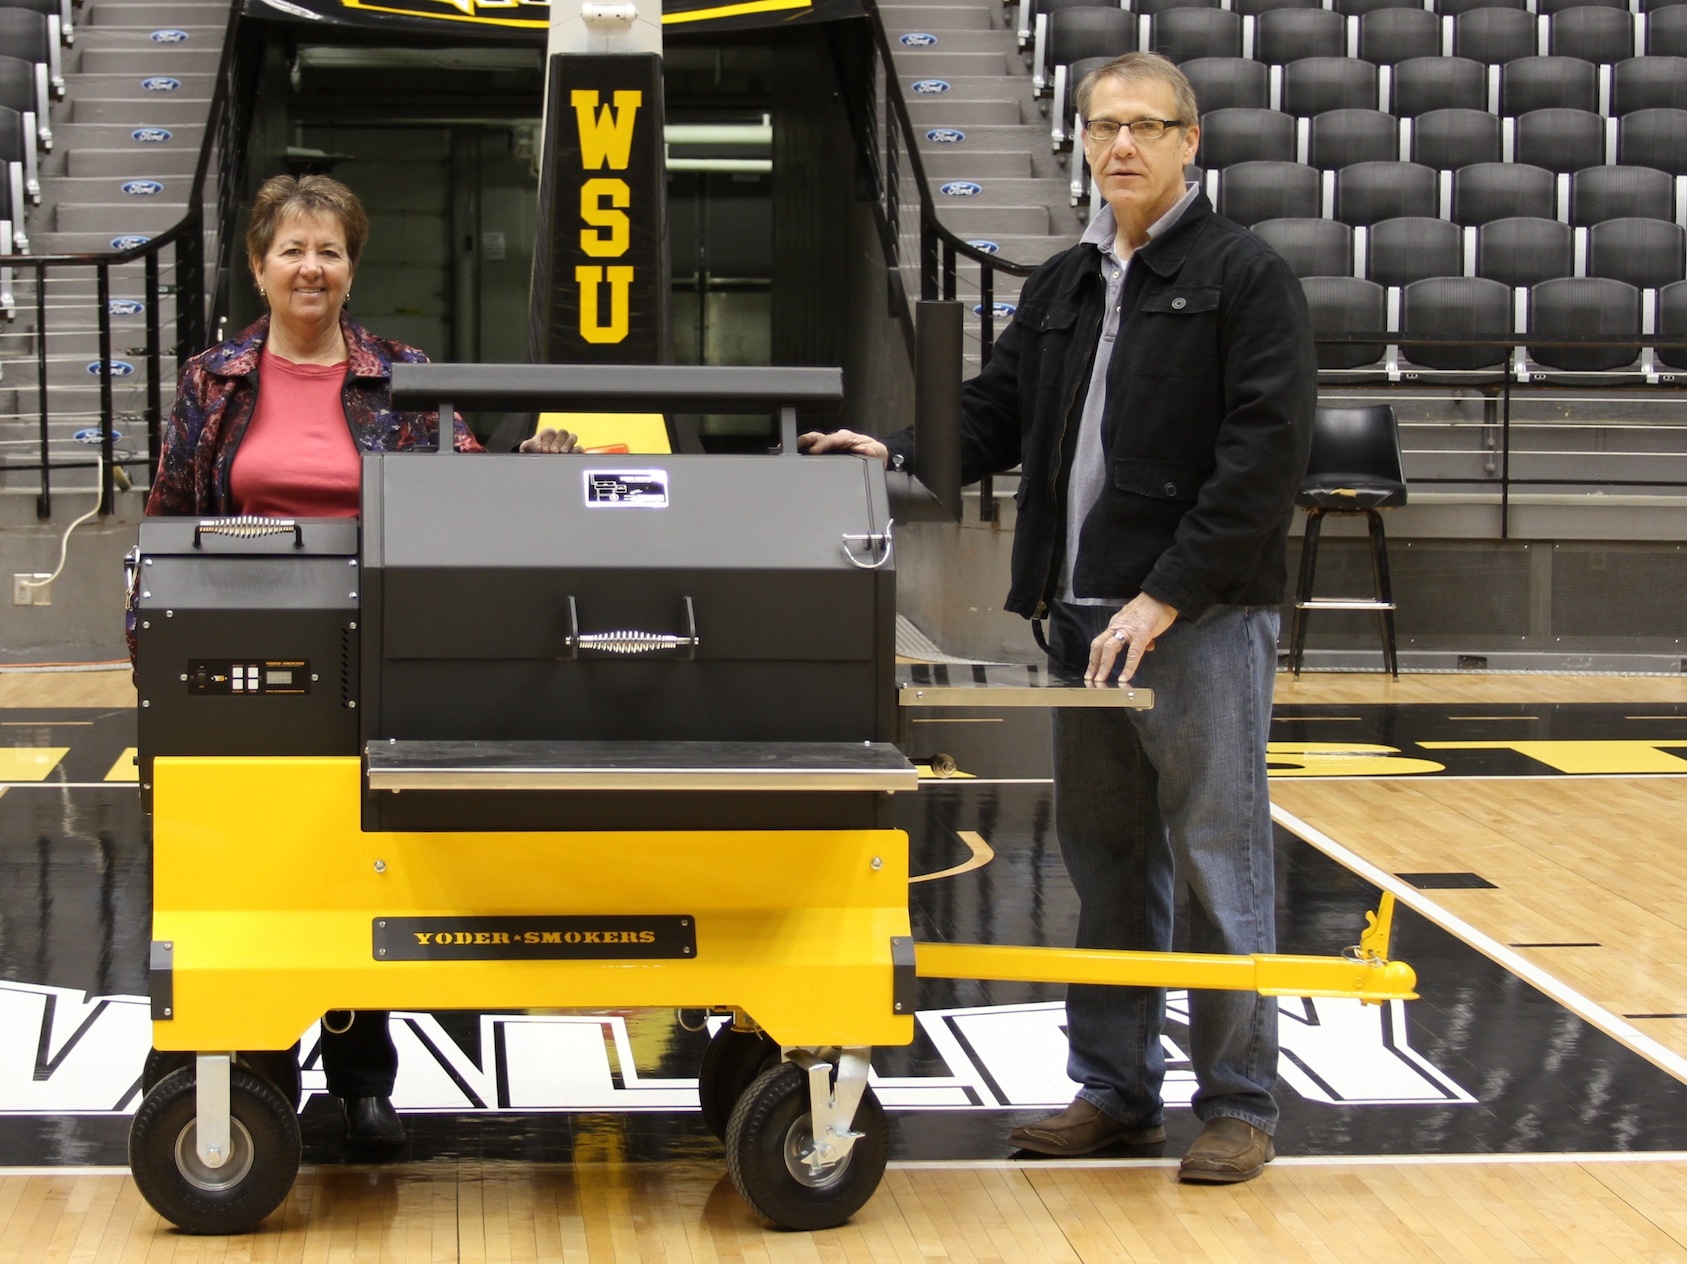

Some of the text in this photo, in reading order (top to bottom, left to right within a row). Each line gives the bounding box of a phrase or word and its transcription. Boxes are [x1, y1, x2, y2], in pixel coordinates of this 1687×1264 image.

[571, 89, 642, 344] WSU
[413, 930, 656, 946] YODER SMOKERS
